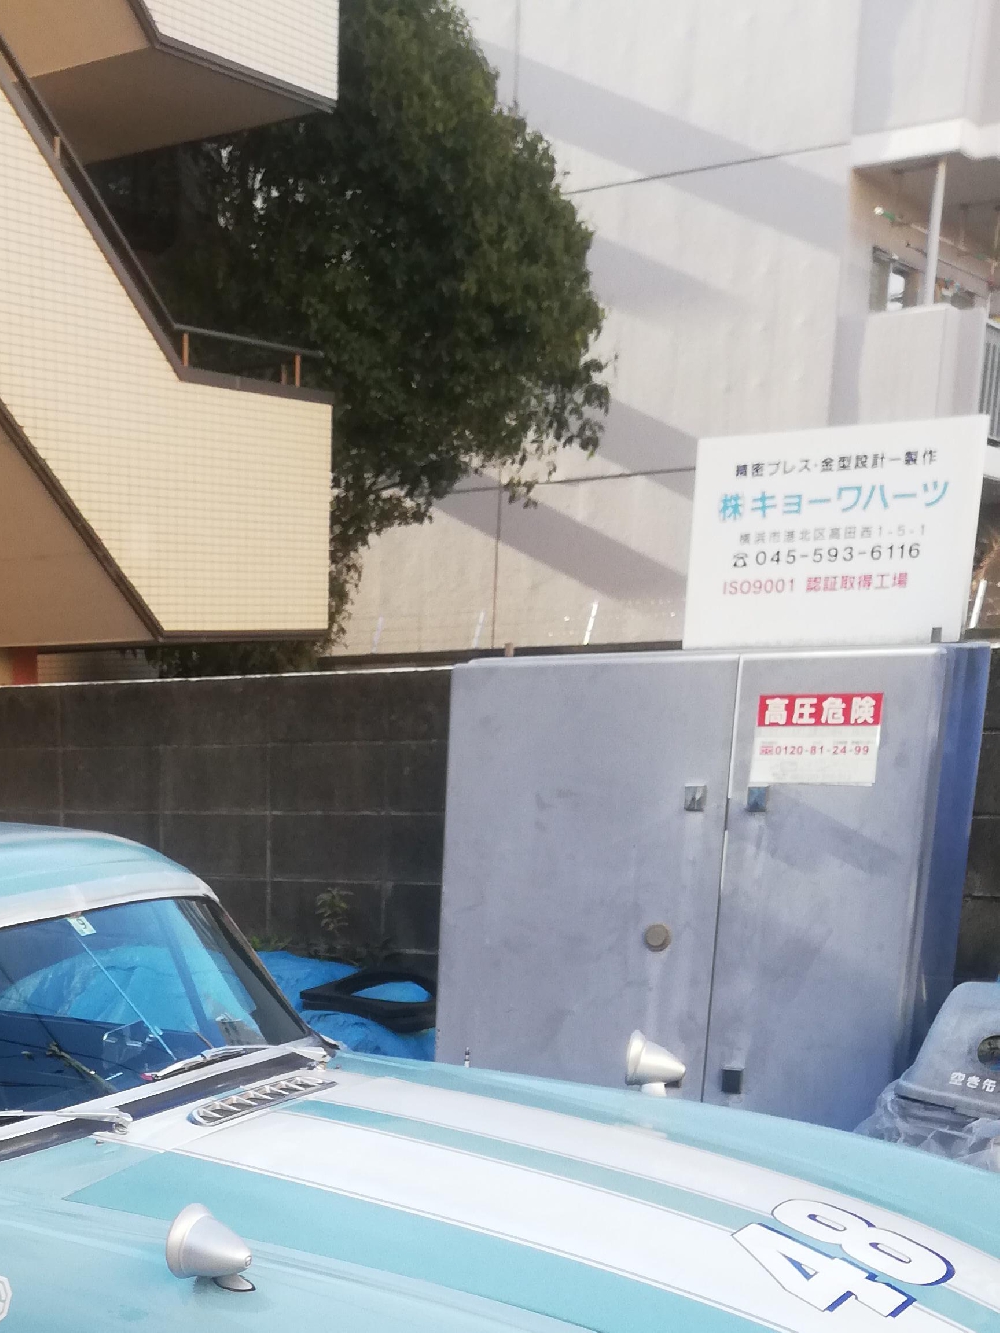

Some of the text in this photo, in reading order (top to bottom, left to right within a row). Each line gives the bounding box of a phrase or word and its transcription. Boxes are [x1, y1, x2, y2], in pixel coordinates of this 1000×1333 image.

[755, 542, 921, 566] 045-593-6116
[722, 572, 909, 595] ISO9001 認証取得工場
[764, 695, 877, 725] 高圧危険
[731, 1198, 956, 1318] 48
